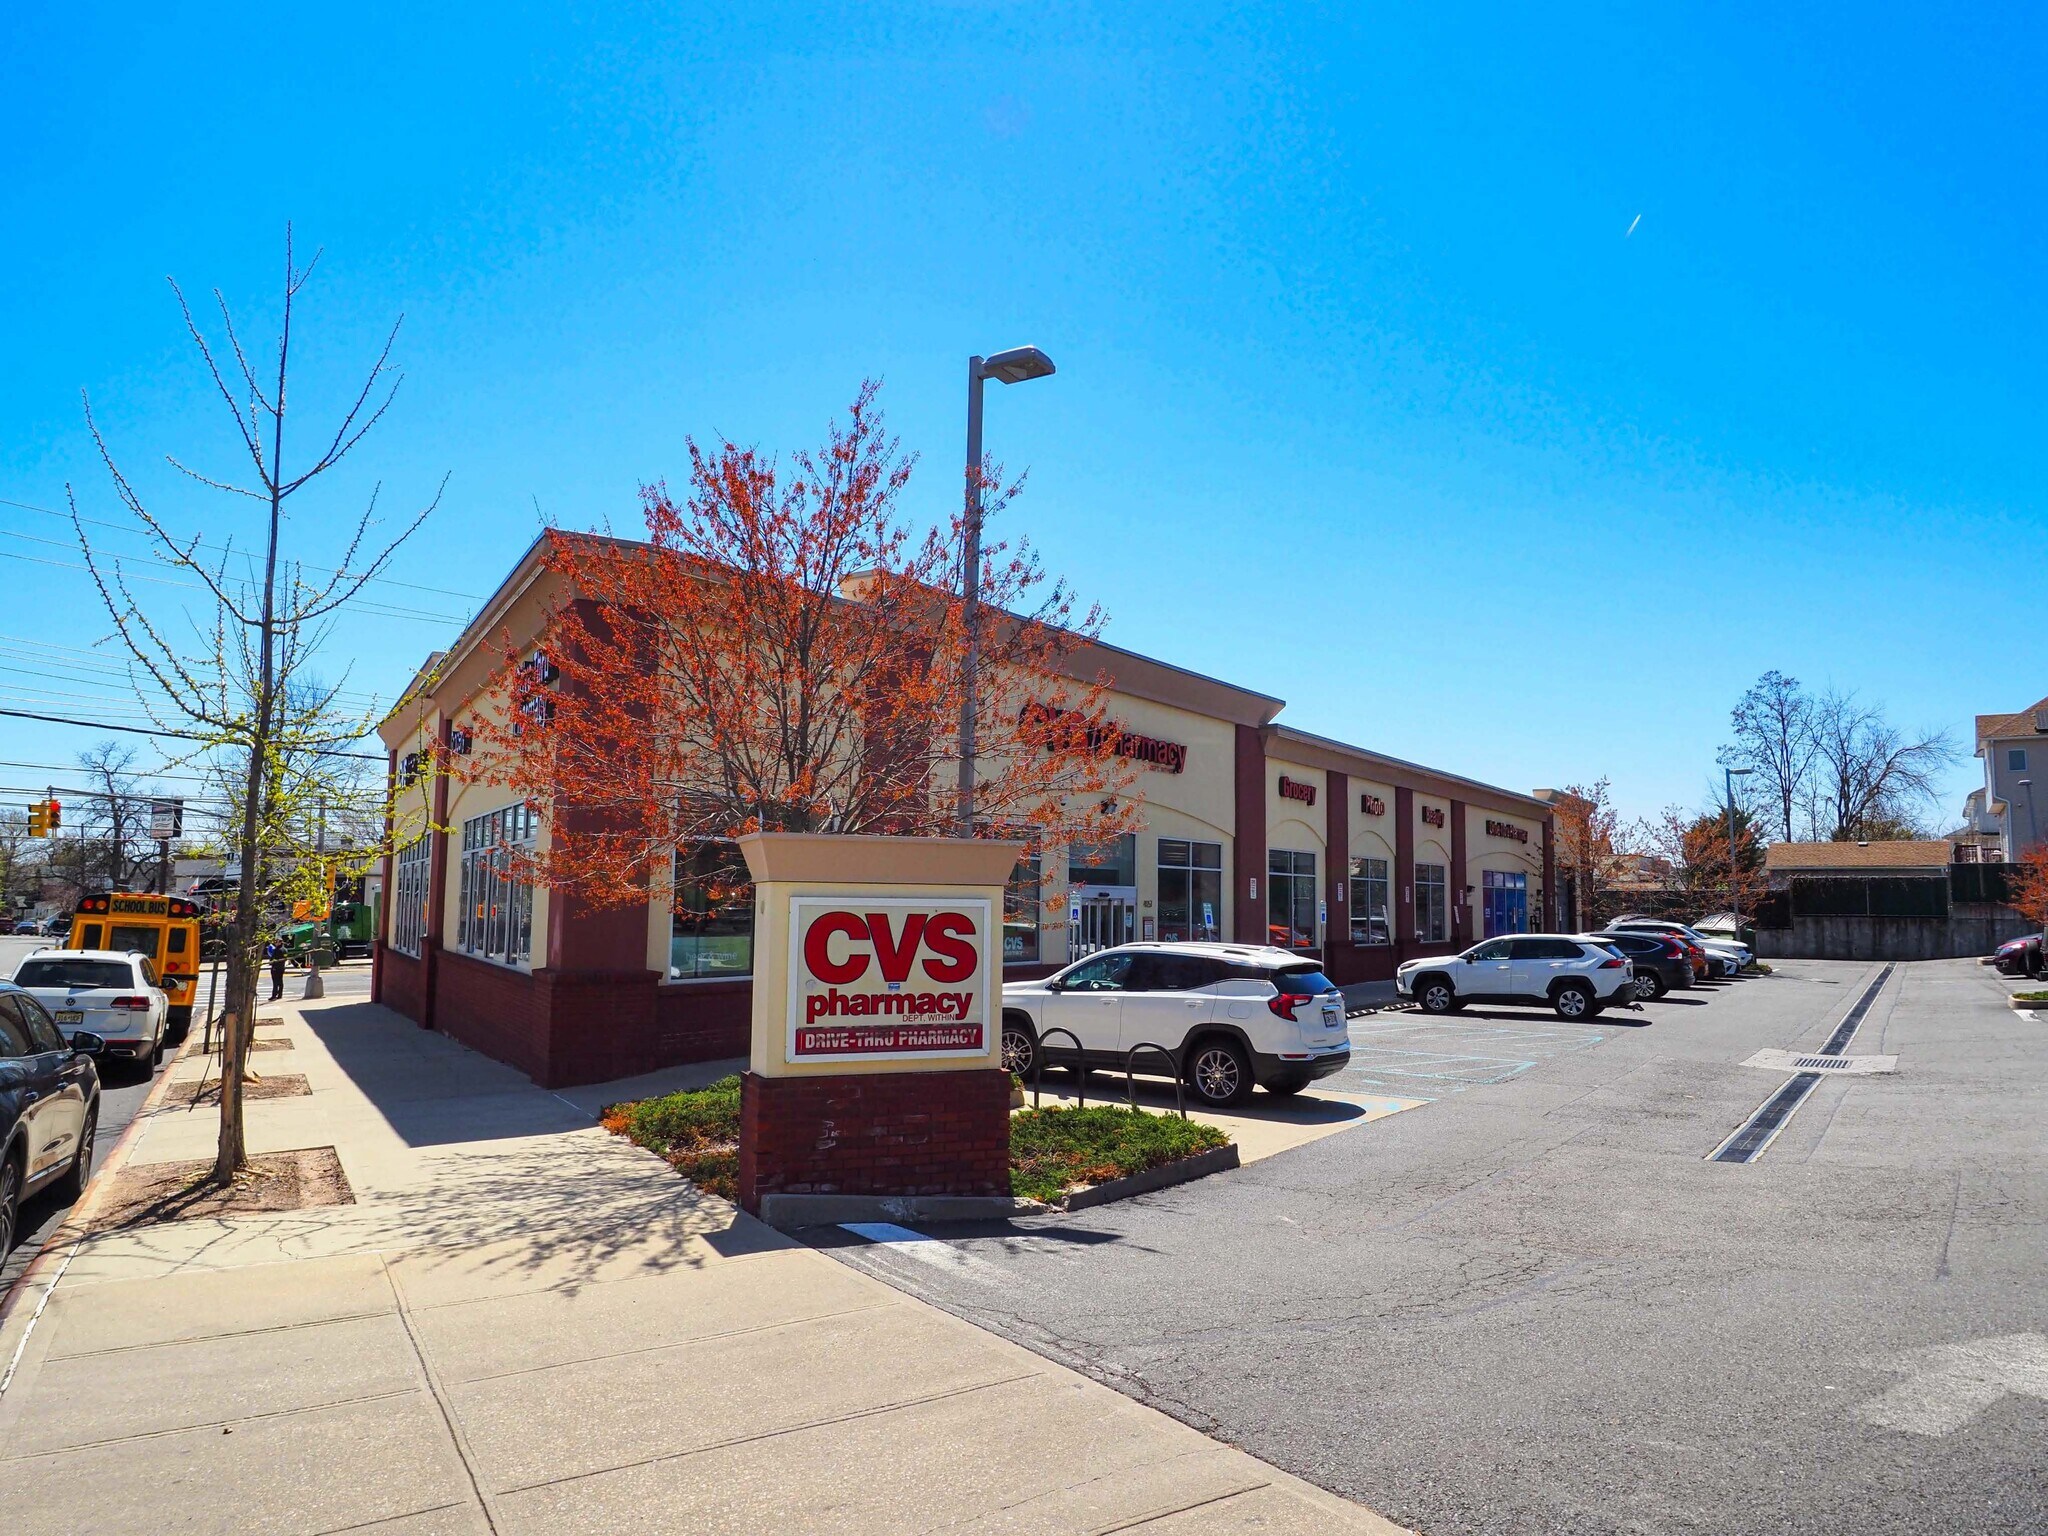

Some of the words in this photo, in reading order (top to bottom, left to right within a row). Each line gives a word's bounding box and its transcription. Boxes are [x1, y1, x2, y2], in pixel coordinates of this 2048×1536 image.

[1279, 776, 1317, 806] Grocery
[113, 900, 146, 913] SCHOOL
[149, 901, 166, 914] BUS
[804, 911, 978, 985] CVS
[1004, 936, 1024, 951] CVS
[806, 988, 973, 1024] pharmacy
[902, 1013, 926, 1022] DEPT.
[928, 1013, 955, 1022] WITHIN
[805, 1030, 894, 1049] DRIVE-THRU
[899, 1028, 977, 1047] PHARMACY
